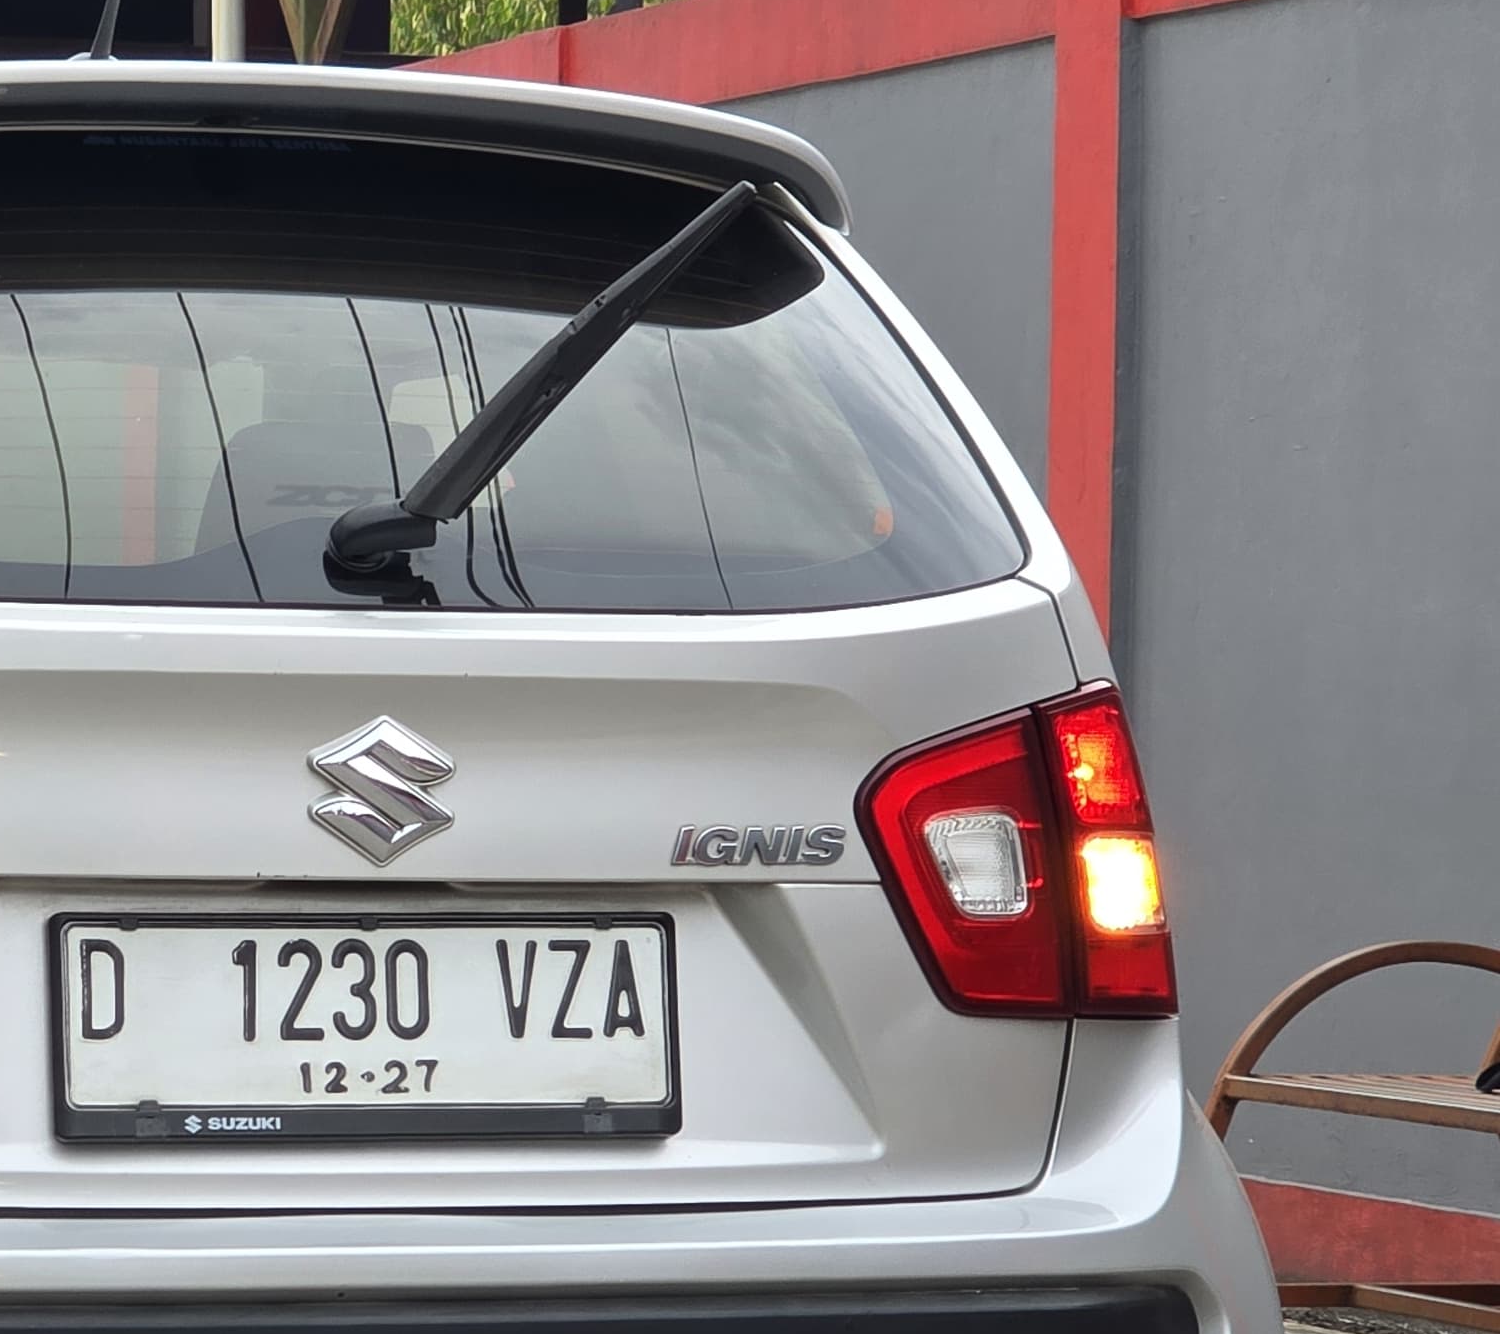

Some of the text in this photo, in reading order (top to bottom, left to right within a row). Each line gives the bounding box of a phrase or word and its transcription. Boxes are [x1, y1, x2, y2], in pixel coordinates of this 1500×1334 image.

[671, 824, 847, 866] IGNIS
[80, 938, 645, 1042] D 1230 VZA
[207, 1116, 282, 1130] SUZUKI
